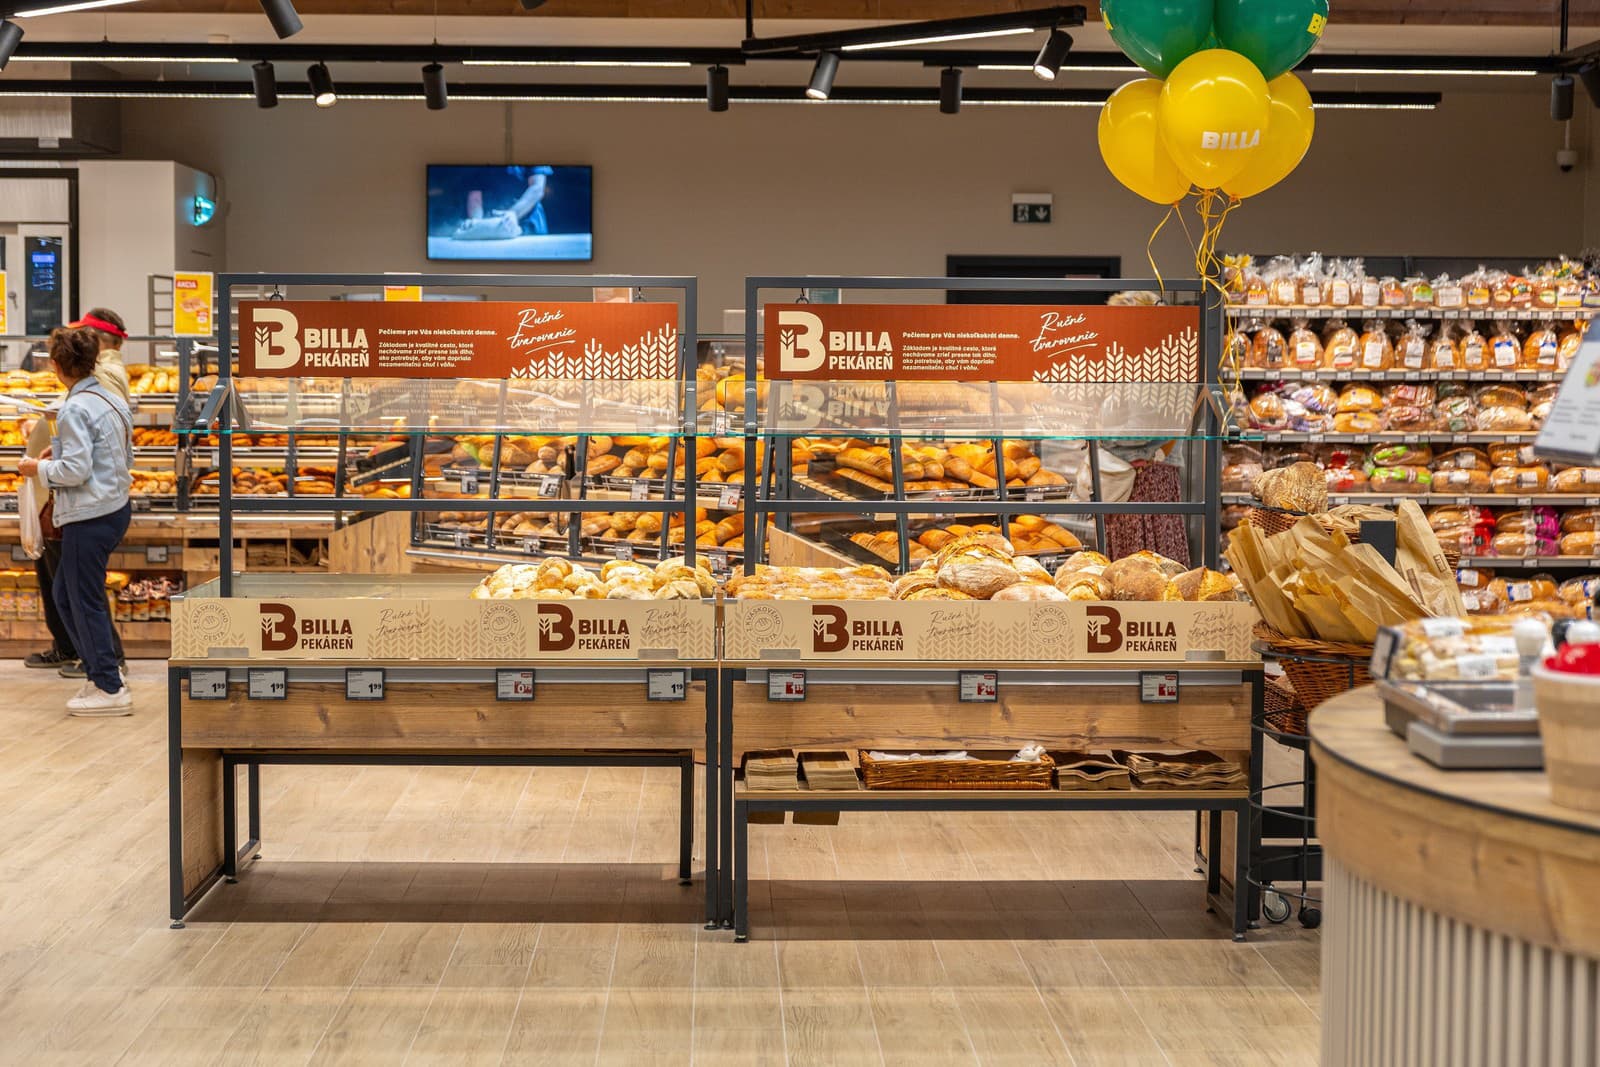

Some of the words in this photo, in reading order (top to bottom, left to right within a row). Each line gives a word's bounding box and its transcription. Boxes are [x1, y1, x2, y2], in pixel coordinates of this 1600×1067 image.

[1201, 129, 1260, 150] BILLA
[518, 308, 564, 328] Ručné
[1041, 312, 1086, 331] Ručné
[304, 328, 369, 348] BILLA
[507, 328, 577, 349] tvarovanie
[829, 331, 893, 351] BILLA
[1029, 331, 1098, 352] tvarovanie
[304, 349, 369, 367] PEKÁREŇ
[829, 352, 893, 370] PEKÁREŇ
[301, 619, 353, 634] BILLA
[578, 619, 630, 635] BILLA
[852, 620, 903, 636] BILLA
[1126, 621, 1177, 637] BILLA
[204, 631, 226, 642] CESTA
[301, 636, 353, 649] PEKÁREŇ
[493, 632, 515, 642] CESTA
[578, 636, 630, 649] PEKÁREŇ
[756, 632, 777, 643] CESTA
[852, 637, 904, 651] PEKÁREŇ
[1043, 633, 1064, 644] CESTA
[1126, 638, 1177, 651] PEKÁREŇ
